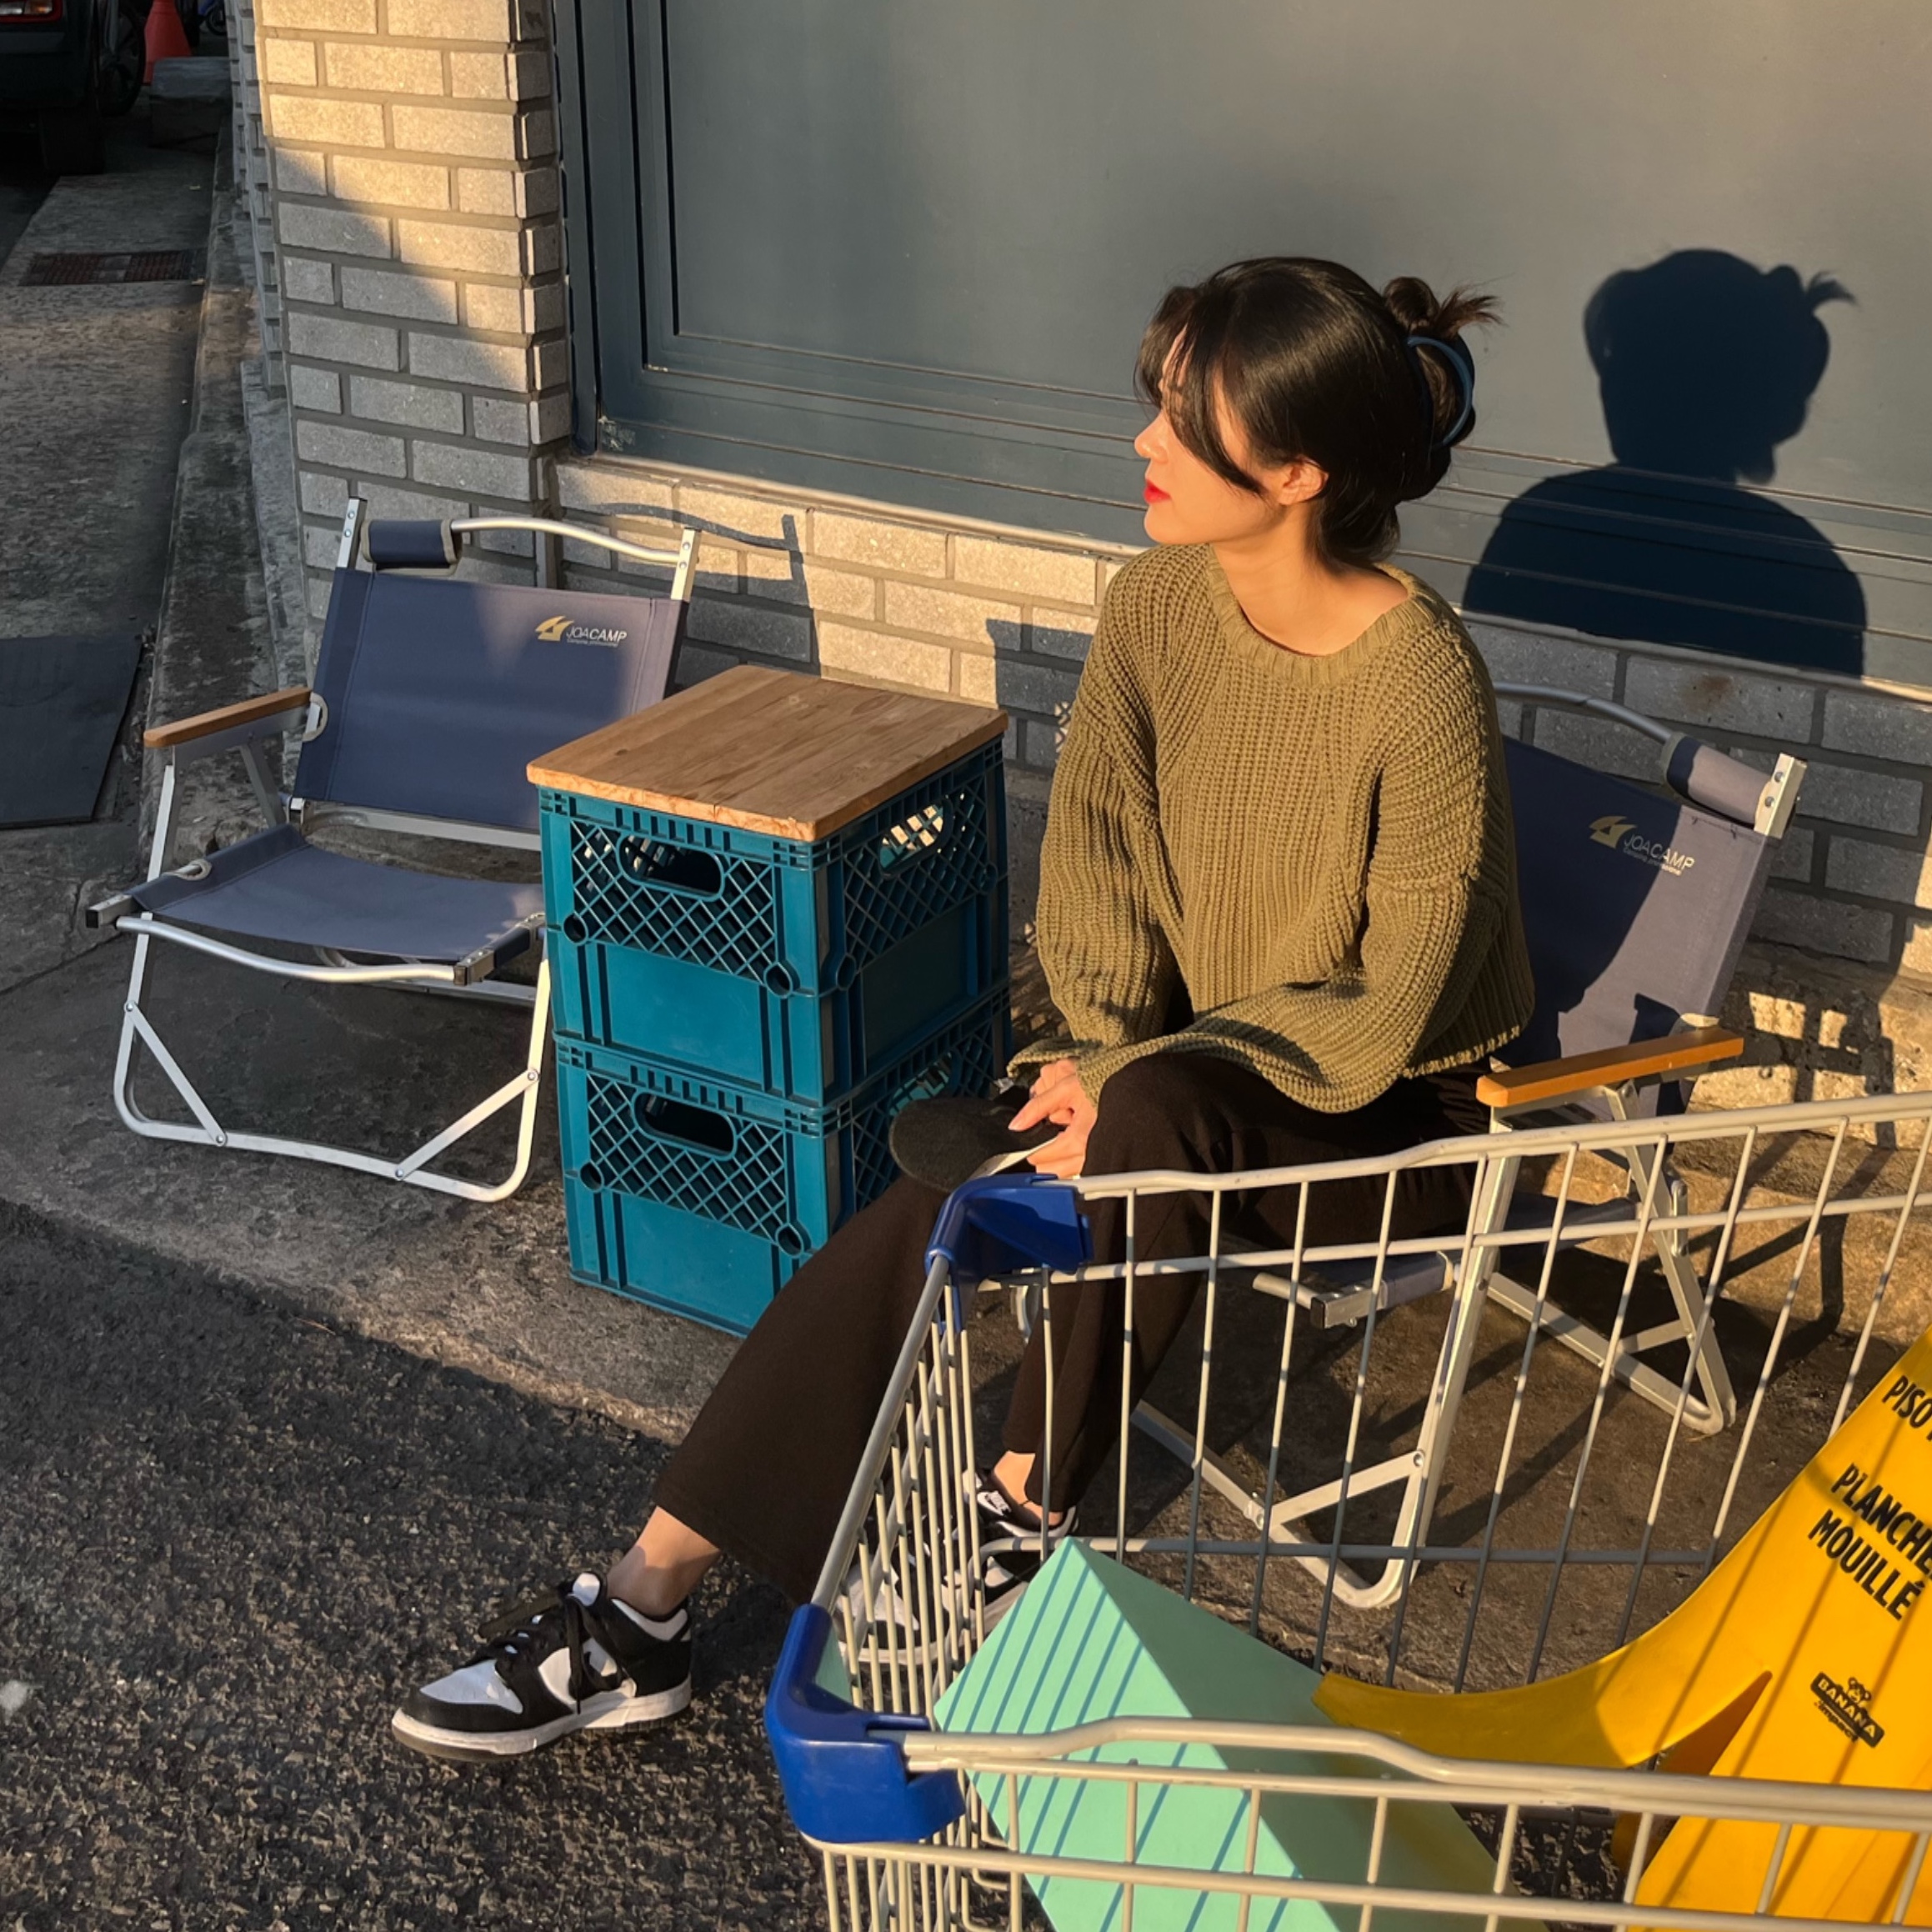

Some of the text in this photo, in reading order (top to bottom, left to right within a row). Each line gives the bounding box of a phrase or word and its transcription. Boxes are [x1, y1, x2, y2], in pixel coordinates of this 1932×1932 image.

[566, 626, 628, 643] JOACAMP
[1624, 833, 1695, 870] JOACAMP
[1881, 1374, 1932, 1429] PISO
[1830, 1462, 1932, 1580] PLANCHE
[1807, 1509, 1926, 1621] MOUILLÉ
[1817, 1678, 1877, 1739] BANANA
